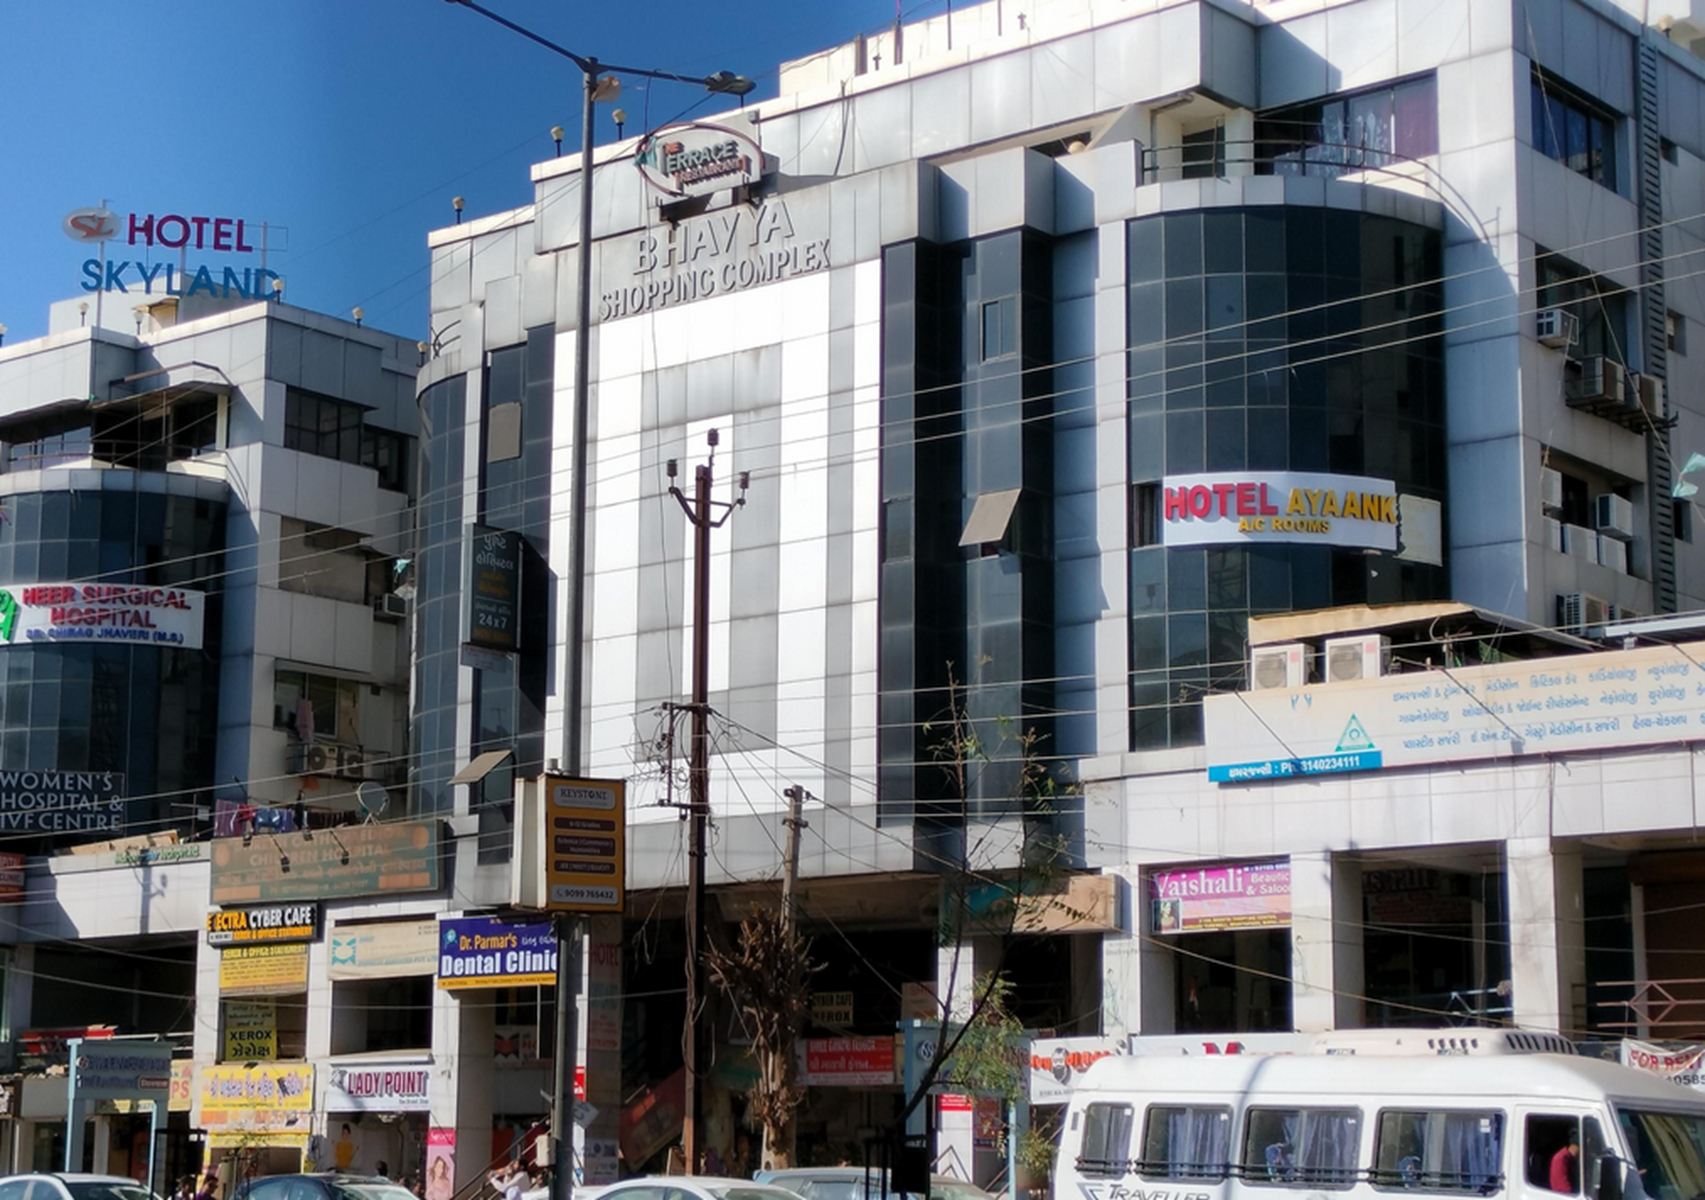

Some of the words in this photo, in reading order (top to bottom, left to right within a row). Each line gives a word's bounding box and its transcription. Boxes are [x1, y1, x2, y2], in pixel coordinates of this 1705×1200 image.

[128, 213, 253, 252] HOTEL
[633, 200, 796, 275] BHAVYA
[81, 259, 281, 300] SKYLAND
[600, 266, 715, 321] SHOPPING
[723, 239, 831, 291] COMPLEX
[1165, 483, 1278, 520] HOTEL
[1286, 489, 1397, 524] AYAANK
[1271, 518, 1331, 533] ROOMS
[82, 586, 191, 610] SURGICAL
[51, 607, 157, 628] HOSPITAL
[0, 772, 112, 791] WOMEN'S
[1, 792, 104, 810] HOSPITAL
[109, 794, 124, 812] &
[1, 813, 34, 829] IVF
[38, 813, 120, 831] CENTRE
[1154, 868, 1243, 897] Vaishali
[250, 909, 282, 928] CYBER
[285, 906, 311, 925] CAFE
[459, 936, 472, 950] Dr.
[474, 933, 518, 949] Parmar's
[441, 952, 501, 976] Dental
[230, 1030, 272, 1041] XEROX
[1629, 1049, 1659, 1068] FOR
[348, 1073, 380, 1095] LADY
[385, 1071, 424, 1094] POINT
